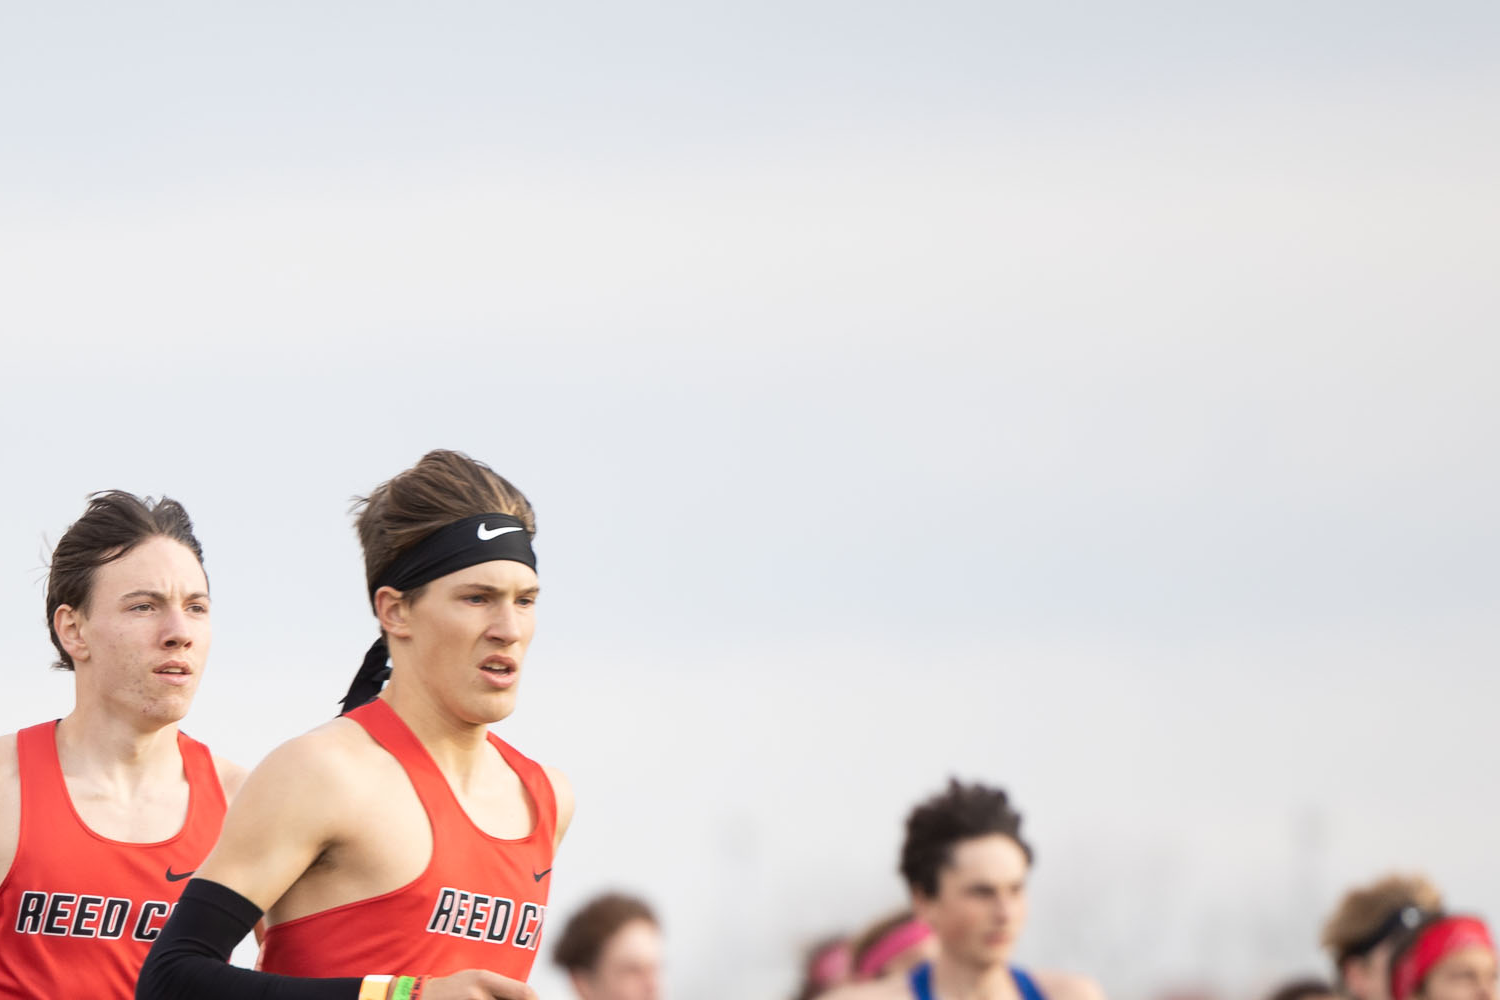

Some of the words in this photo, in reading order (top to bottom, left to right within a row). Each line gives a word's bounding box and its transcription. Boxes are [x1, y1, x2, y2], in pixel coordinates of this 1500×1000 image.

[15, 891, 132, 940] REED
[132, 900, 179, 943] C
[426, 887, 514, 944] REED
